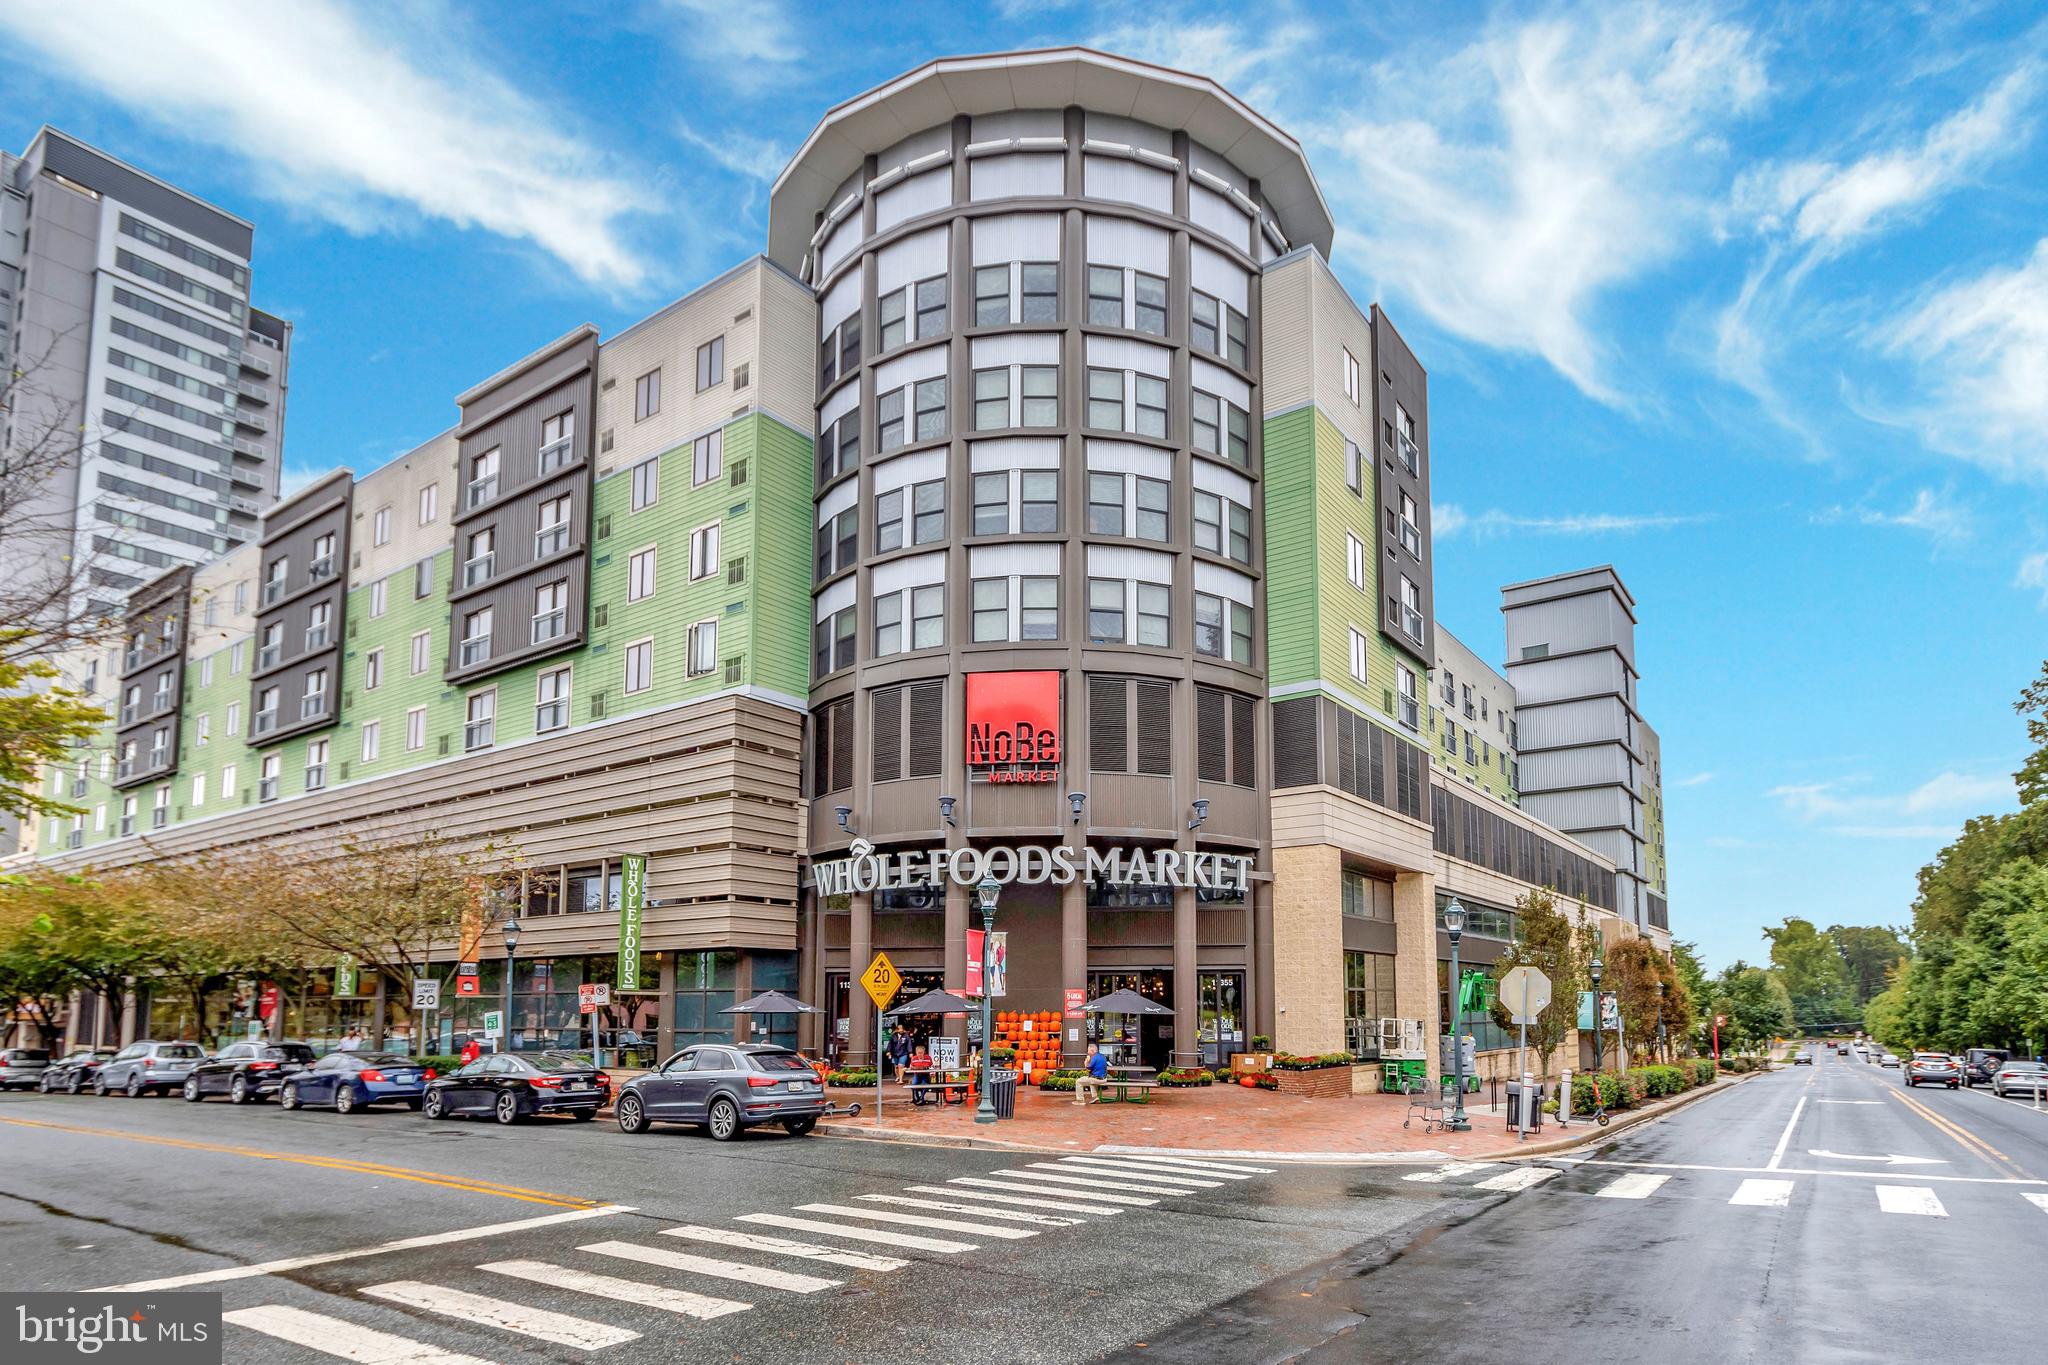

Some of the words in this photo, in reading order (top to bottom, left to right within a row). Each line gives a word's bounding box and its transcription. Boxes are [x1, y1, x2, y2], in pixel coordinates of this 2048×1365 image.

[970, 721, 1056, 762] NoBe
[988, 770, 1058, 782] MARKET
[812, 838, 926, 898] WHOLE
[927, 845, 1077, 886] FOODS
[1083, 846, 1254, 892] MARKET
[627, 858, 640, 921] WHOLE
[624, 924, 637, 985] FOODS
[873, 968, 890, 984] 20
[416, 994, 436, 1005] 20
